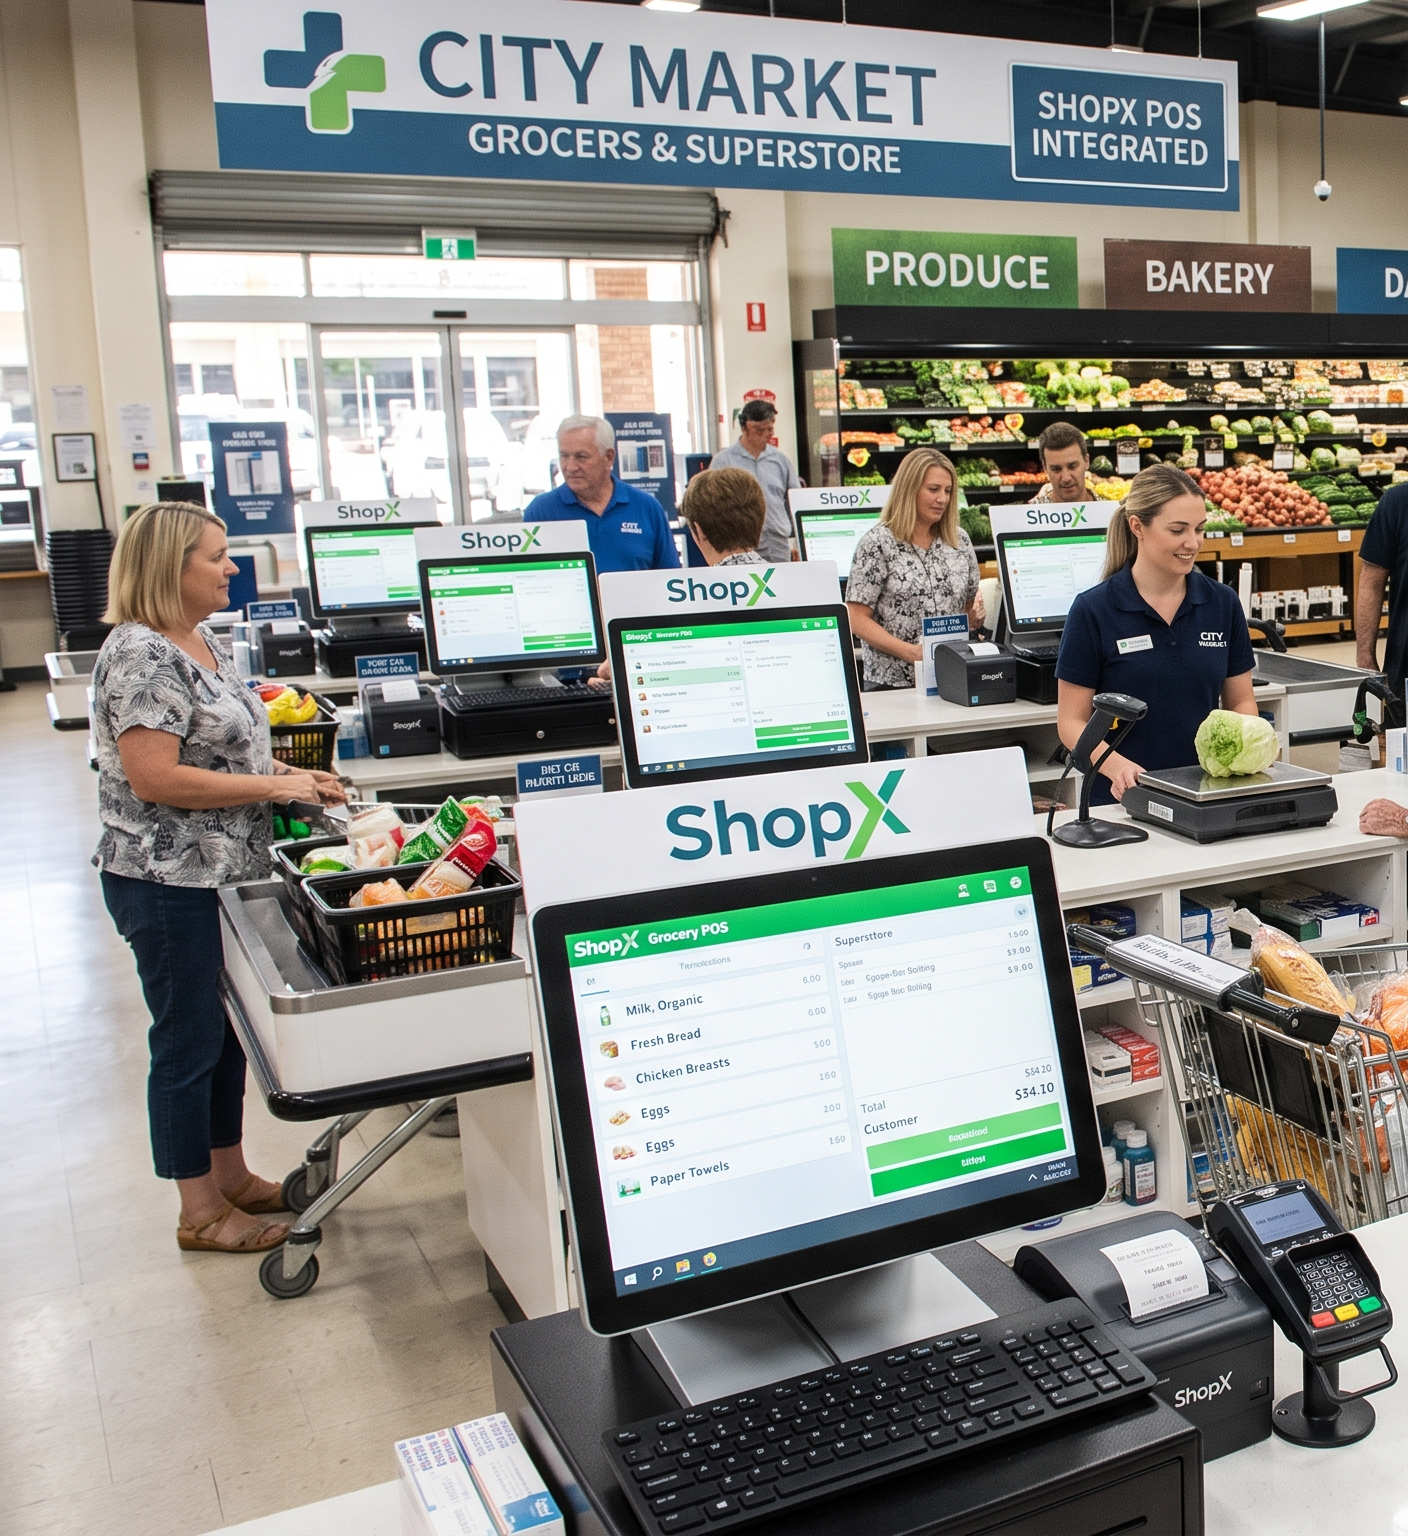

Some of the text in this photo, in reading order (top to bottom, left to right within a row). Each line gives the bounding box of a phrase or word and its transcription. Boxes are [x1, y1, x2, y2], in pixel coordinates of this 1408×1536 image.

[419, 31, 936, 126] CITY MARKET
[1038, 91, 1202, 131] SHOPX POS
[468, 122, 901, 174] GROCERS & SUPERSTORE
[1032, 128, 1209, 166] INTEGRATED
[866, 251, 1049, 290] PRODUCE
[1147, 260, 1274, 294] BAKERY
[820, 489, 870, 506] ShopX
[338, 501, 400, 521] ShopX
[1026, 505, 1087, 528] ShopX
[461, 525, 542, 552] ShopX
[667, 568, 777, 607] ShopX
[1201, 632, 1224, 641] CITY
[666, 769, 911, 862] ShopX
[574, 921, 729, 957] ShopX Grocery POS
[626, 994, 703, 1016] Milk, Organic
[631, 1027, 701, 1050] Fresh Bread
[636, 1057, 730, 1084] Chicken Breasts
[1015, 1082, 1055, 1100] $34.10
[641, 1104, 670, 1120] Eggs
[861, 1100, 886, 1114] Total
[864, 1115, 918, 1135] Customer
[646, 1138, 675, 1153] Eggs
[650, 1160, 730, 1186] Paper Towels
[1175, 1371, 1233, 1408] ShopX
